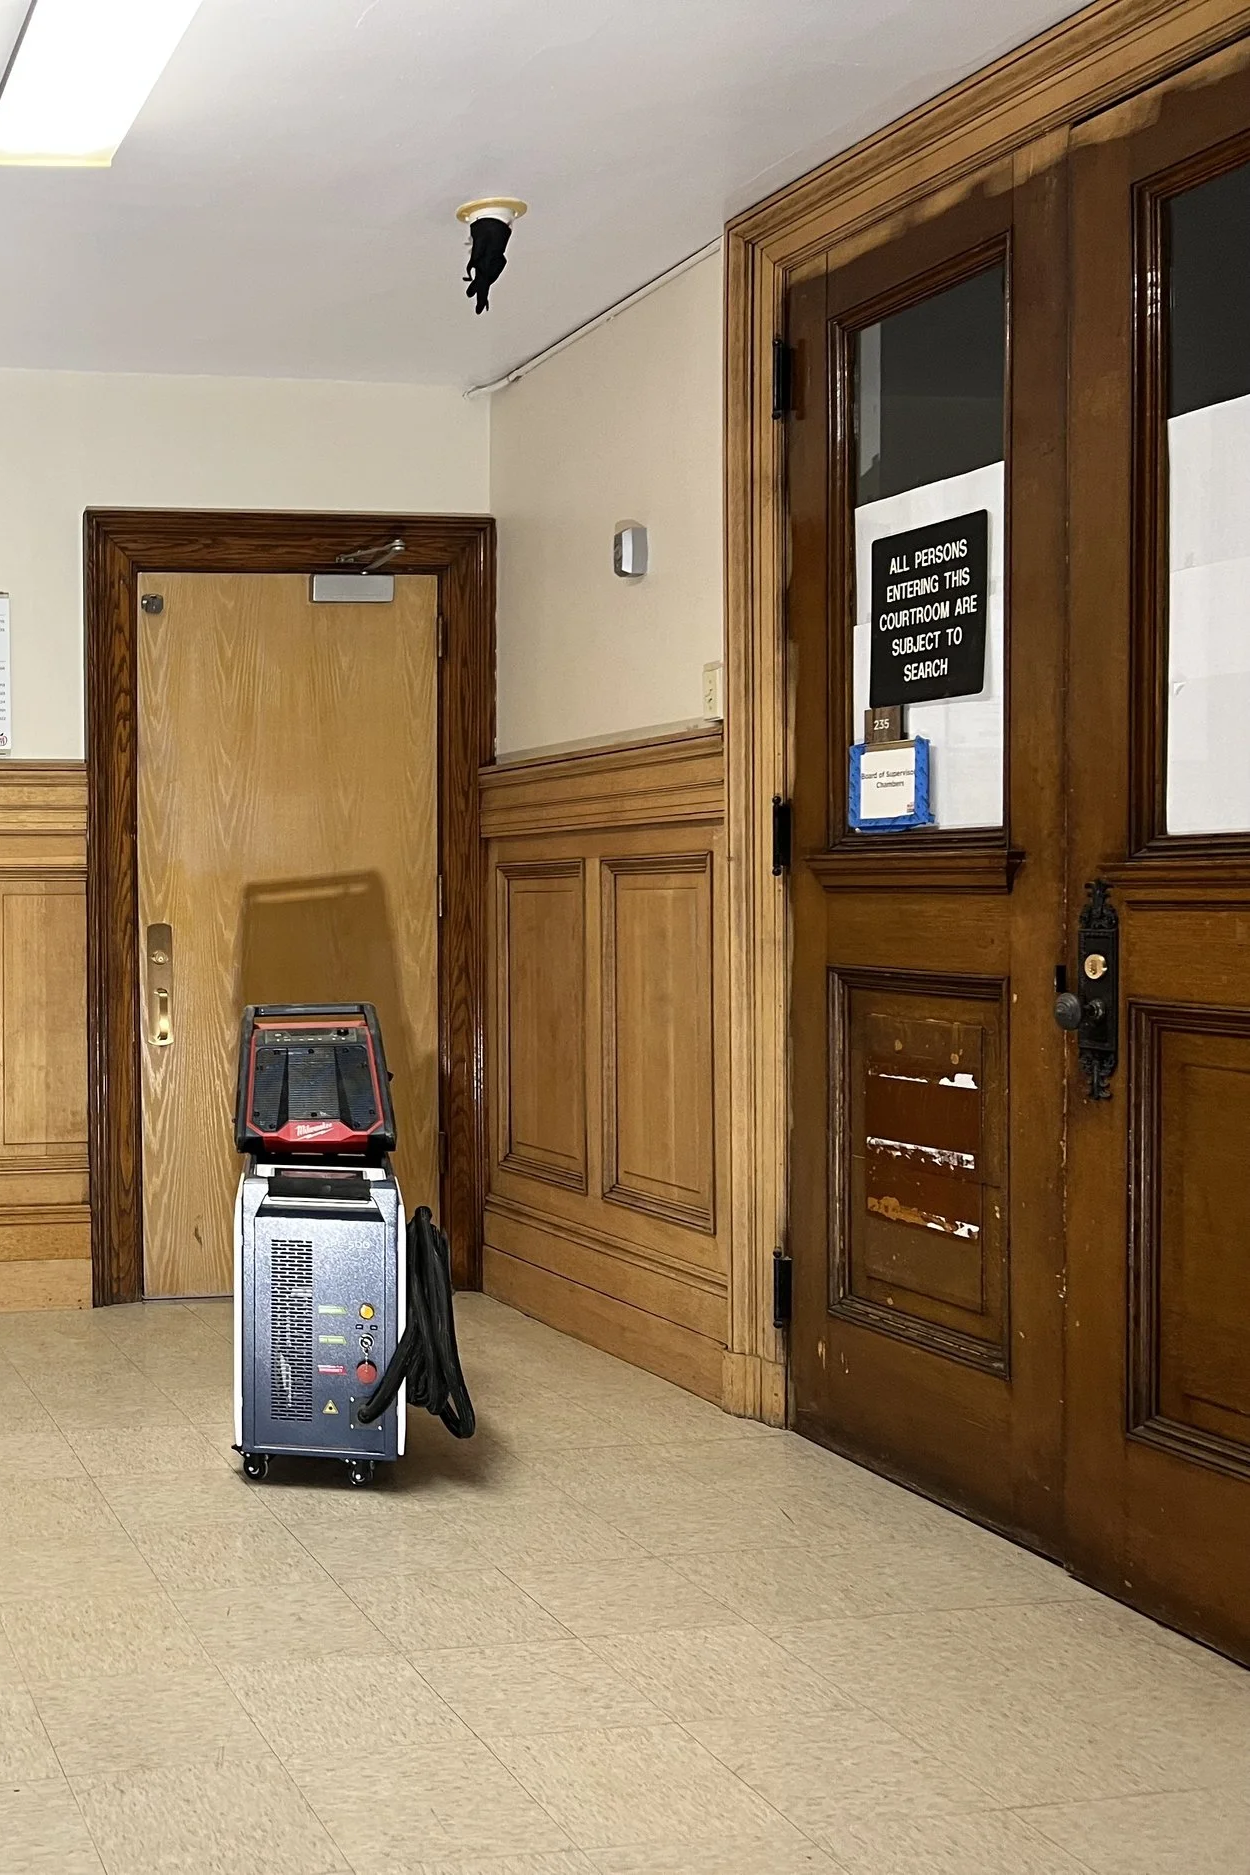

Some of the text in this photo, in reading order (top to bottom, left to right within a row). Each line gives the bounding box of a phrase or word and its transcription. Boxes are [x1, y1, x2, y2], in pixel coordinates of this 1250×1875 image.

[889, 538, 968, 575] ALL PERSONS
[886, 567, 970, 603] ENTERING THIS
[879, 594, 978, 632] COURTROOM ARE
[891, 626, 963, 657] SUBJECT TO
[903, 657, 949, 682] SEARCH
[873, 718, 890, 731] 235
[861, 771, 878, 780] Board
[878, 770, 886, 779] of
[876, 780, 905, 789] Chambers
